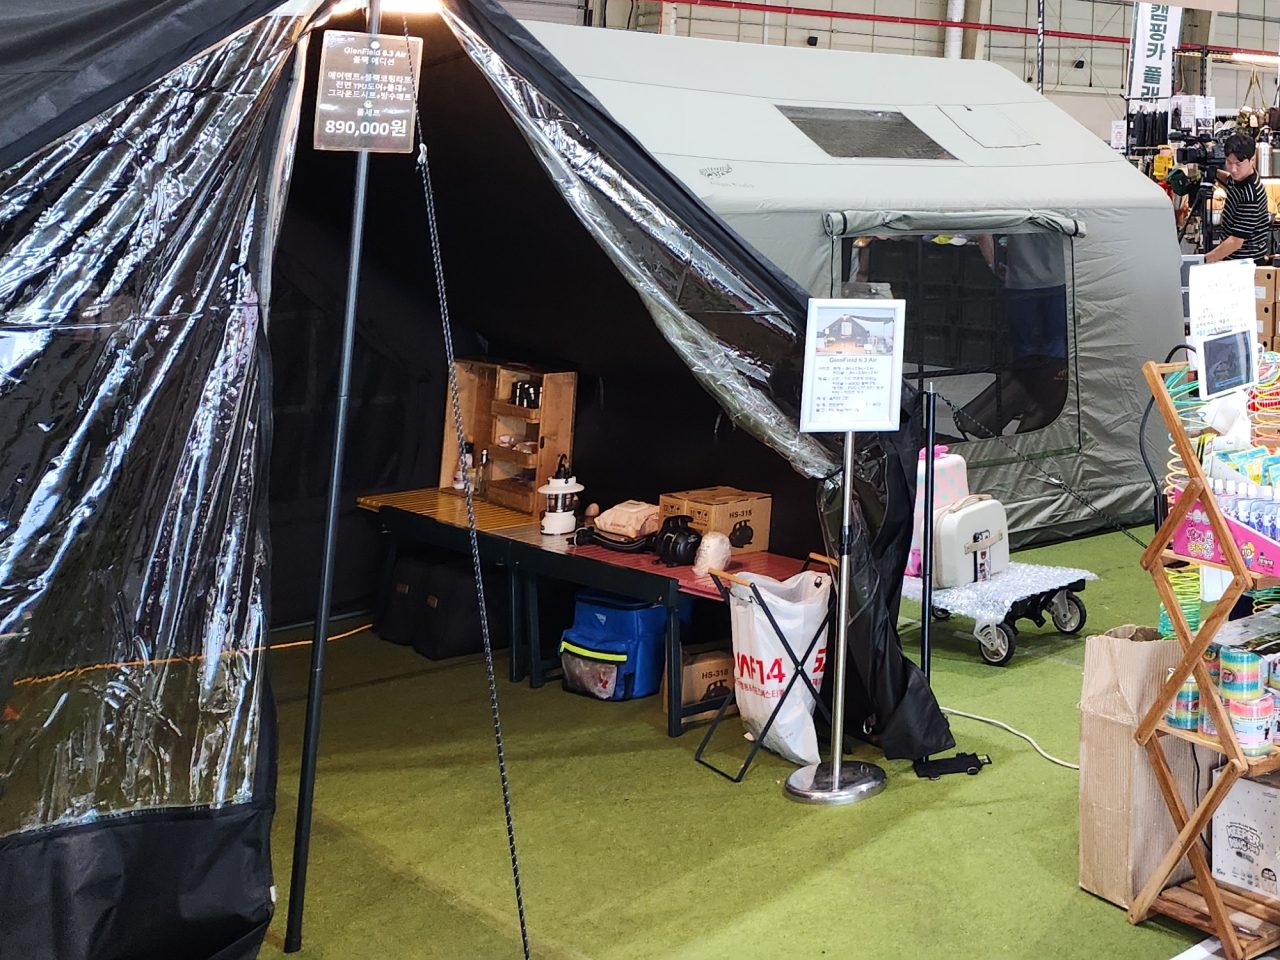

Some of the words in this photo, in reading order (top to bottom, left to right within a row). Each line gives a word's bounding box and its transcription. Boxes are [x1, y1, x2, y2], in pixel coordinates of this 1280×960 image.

[1146, 3, 1168, 61] 캠핑카
[344, 47, 380, 56] GlenField
[325, 120, 407, 137] 890,000원
